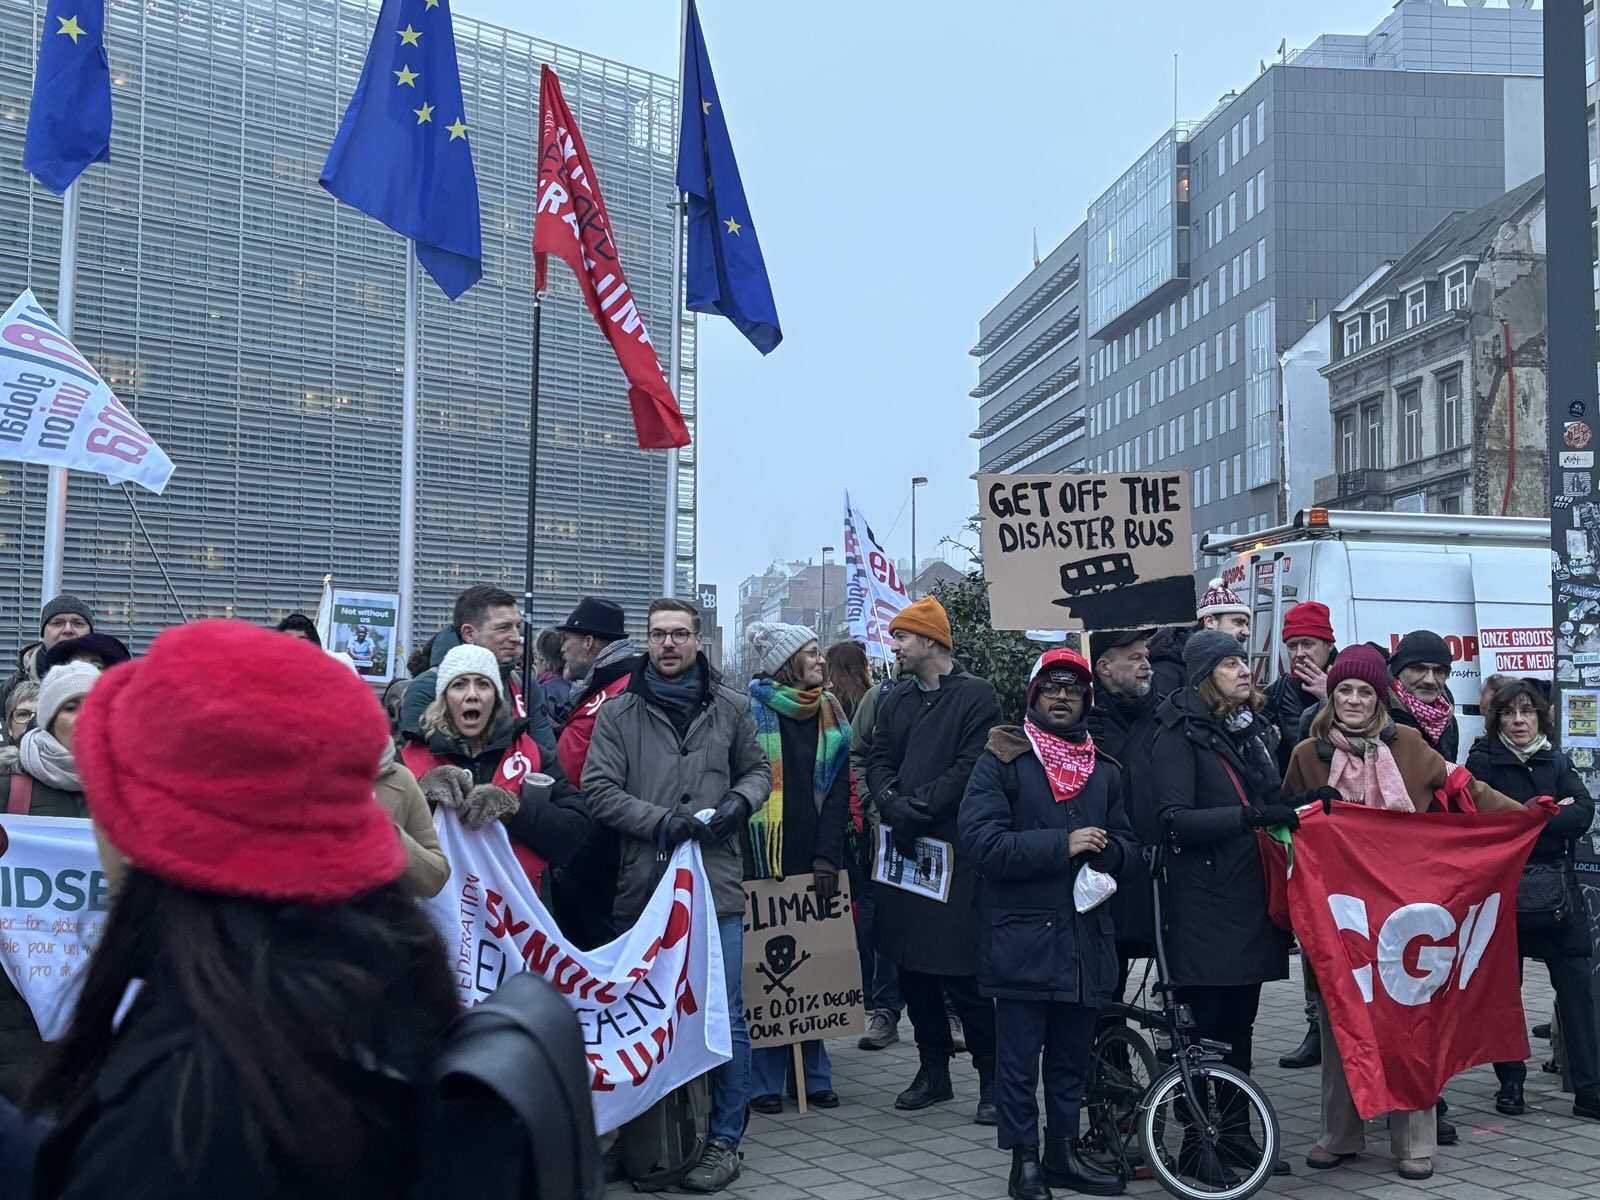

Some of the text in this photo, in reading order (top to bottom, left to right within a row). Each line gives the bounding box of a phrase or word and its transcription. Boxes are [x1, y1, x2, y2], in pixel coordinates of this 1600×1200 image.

[988, 475, 1182, 519] GET OFF THE
[999, 516, 1175, 553] DISASTER BUS
[341, 607, 389, 618] Not without
[1482, 631, 1510, 647] ONZE
[1497, 655, 1525, 670] ONZE
[744, 887, 851, 932] LIMATE:
[24, 914, 43, 931] for
[28, 942, 55, 958] pour
[769, 992, 820, 1019] 0.01%
[750, 1011, 850, 1040] OUR FUTURE
